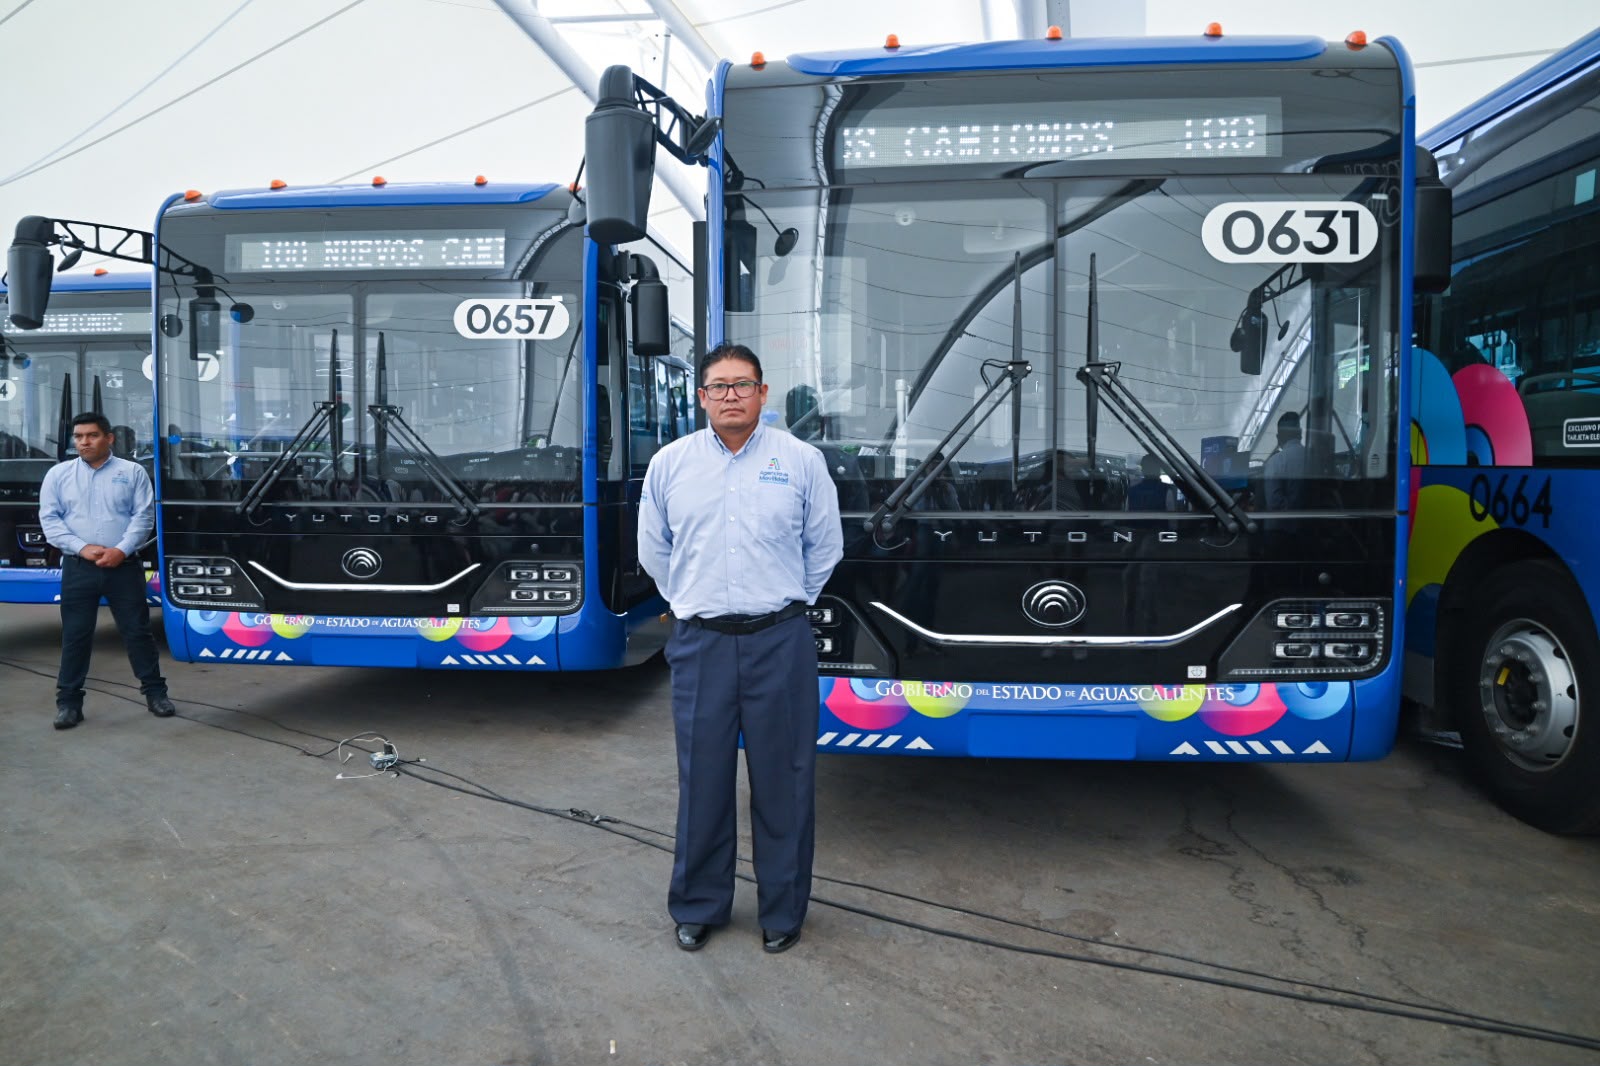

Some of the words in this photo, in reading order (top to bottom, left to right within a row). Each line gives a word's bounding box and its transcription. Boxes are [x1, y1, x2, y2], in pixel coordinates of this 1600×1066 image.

[1185, 117, 1255, 151] 100
[1222, 209, 1360, 255] 0631
[323, 239, 424, 268] NUEVOS
[466, 303, 556, 335] 0657
[1469, 473, 1552, 529] 0664
[285, 513, 438, 523] YUTONG
[934, 530, 1178, 543] YUTONG
[254, 613, 314, 627] GOBIERNO
[326, 617, 370, 628] ESTADO
[380, 617, 481, 629] AGUASCALIENTES
[875, 680, 973, 699] GOBIERNO
[976, 688, 991, 696] DEL
[992, 685, 1062, 700] ESTADO
[1065, 690, 1076, 698] DE
[1079, 686, 1236, 701] AGUASCALIENTES
